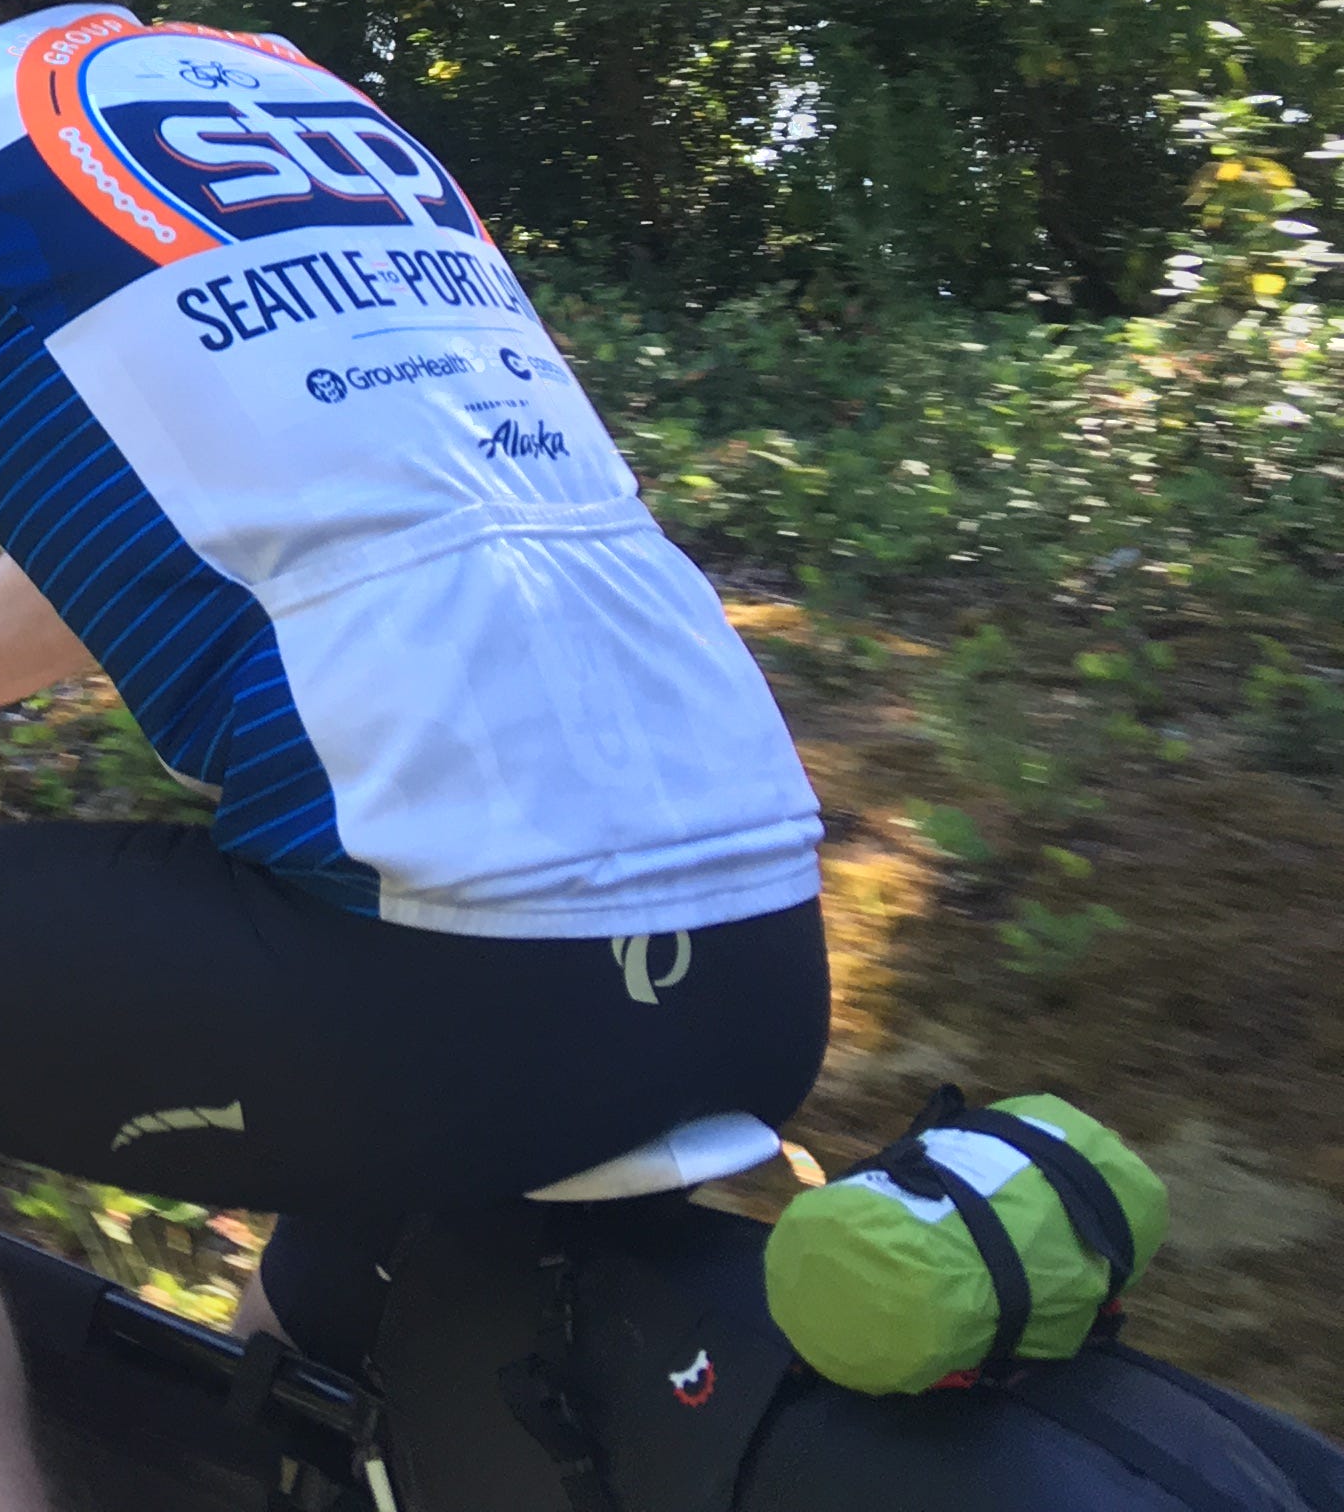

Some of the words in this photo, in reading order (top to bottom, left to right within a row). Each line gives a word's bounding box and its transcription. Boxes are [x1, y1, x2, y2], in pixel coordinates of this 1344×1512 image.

[43, 17, 123, 65] GROUP
[176, 251, 398, 353] SEATTLE
[346, 355, 473, 391] GroupHealth
[478, 418, 570, 461] Alaska
